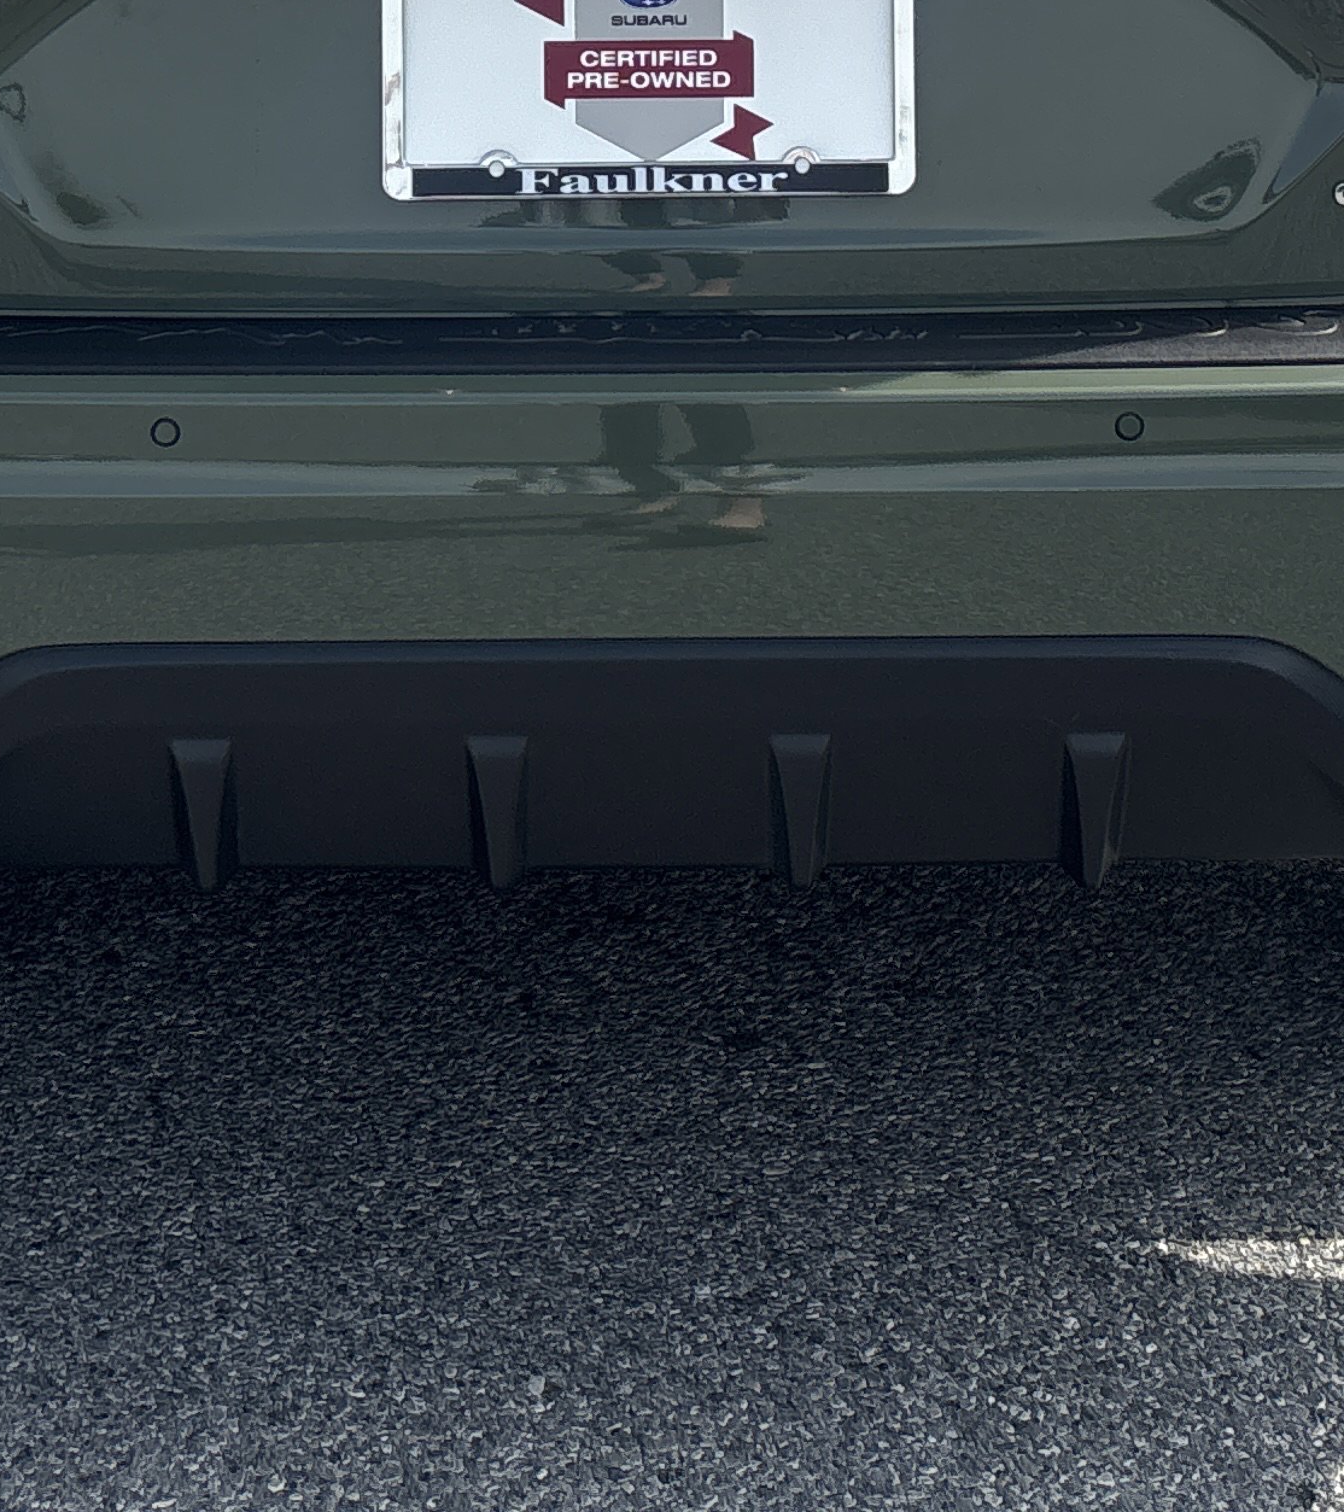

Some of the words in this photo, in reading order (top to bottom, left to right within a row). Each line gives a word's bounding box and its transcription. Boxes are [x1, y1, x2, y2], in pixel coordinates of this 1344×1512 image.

[610, 14, 688, 27] SUBARU
[579, 49, 718, 68] CERTIFIED
[567, 72, 731, 90] PRE-OWNED
[517, 167, 789, 194] Faulkner
